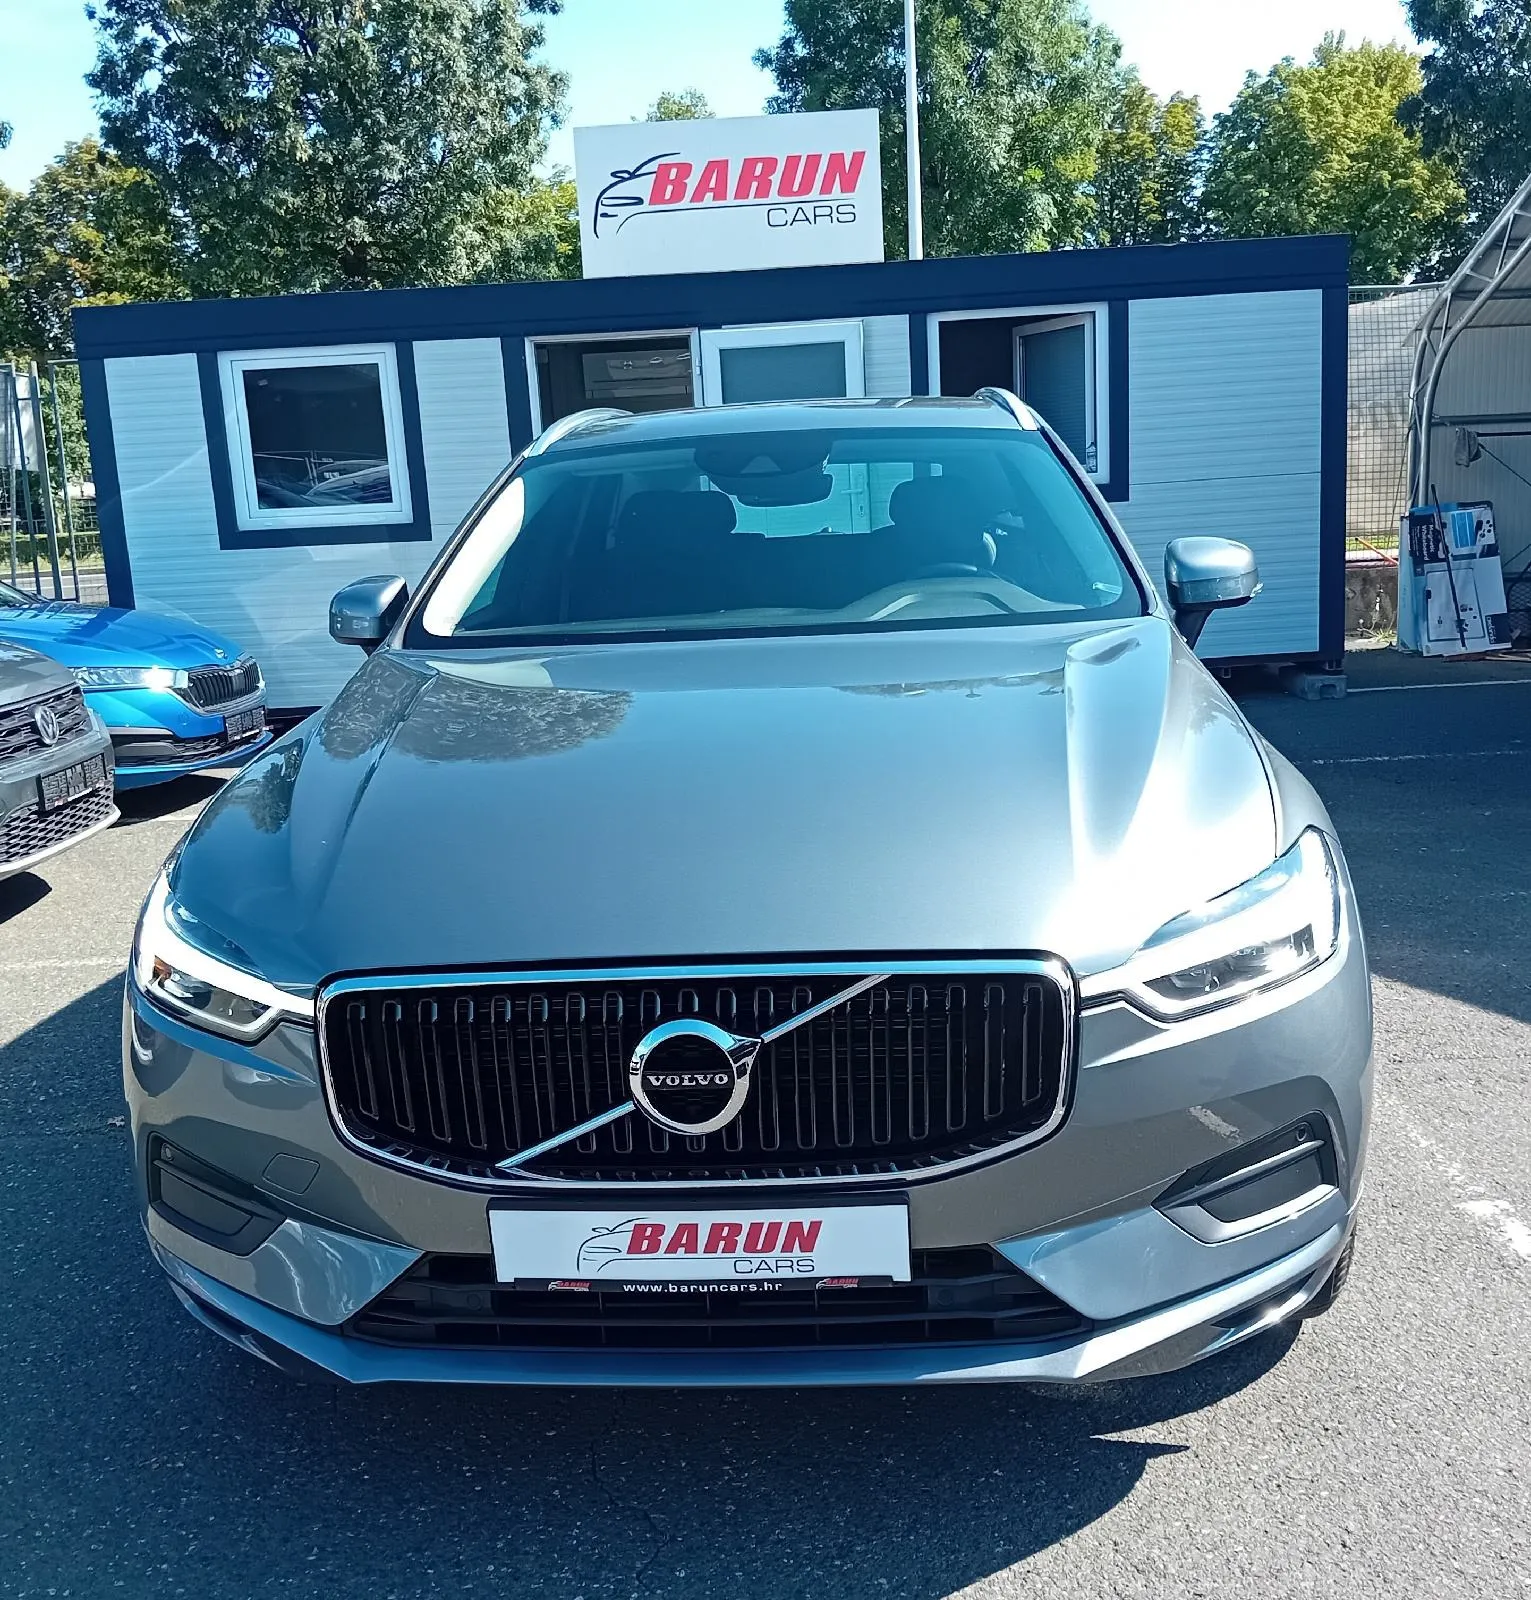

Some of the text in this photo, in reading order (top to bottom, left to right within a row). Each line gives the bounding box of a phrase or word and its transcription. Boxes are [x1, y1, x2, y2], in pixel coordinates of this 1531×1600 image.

[648, 151, 866, 206] BARUN
[766, 204, 857, 228] CARS
[646, 1073, 729, 1086] VOLVO
[626, 1220, 823, 1255] BARUN
[733, 1258, 816, 1275] CARS
[623, 1281, 783, 1293] www.baruncars.hr
